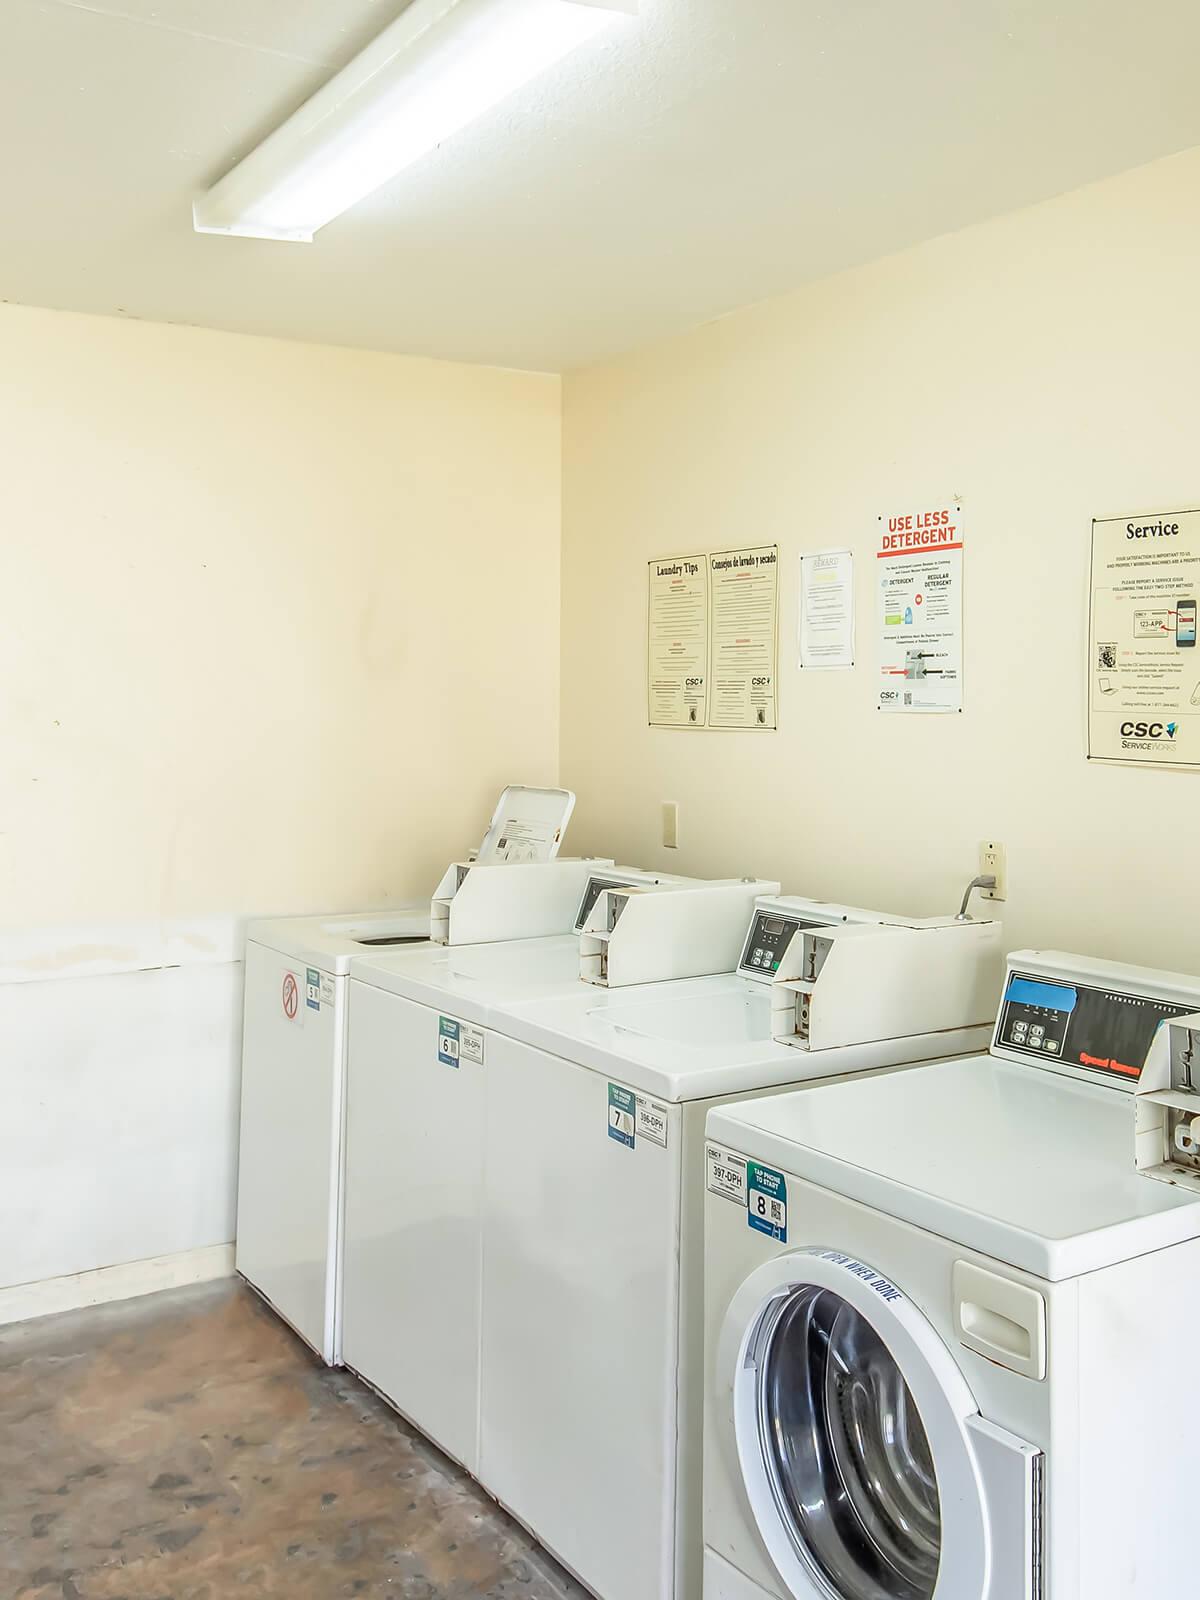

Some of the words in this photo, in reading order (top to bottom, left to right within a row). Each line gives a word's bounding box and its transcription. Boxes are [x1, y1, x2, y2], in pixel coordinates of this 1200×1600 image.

[889, 516, 912, 532] USE
[917, 511, 948, 528] LESS
[1127, 521, 1179, 539] Service
[883, 527, 956, 549] DETERGENT
[656, 564, 683, 576] Laundry
[684, 562, 698, 575] Tips
[712, 558, 732, 571] Consejos
[733, 556, 738, 566] de
[739, 555, 755, 566] lavado
[756, 557, 758, 568] y
[760, 552, 776, 564] secado
[752, 677, 766, 685] CSC
[1120, 722, 1163, 737] CSC
[310, 987, 313, 998] 5
[1105, 994, 1145, 1006] PERMANENT
[1154, 1004, 1176, 1013] PRESS
[444, 1039, 448, 1052] 6
[615, 1110, 620, 1126] 7
[714, 1166, 741, 1186] 397-DPH
[764, 1179, 778, 1190] START
[757, 1196, 765, 1215] 8
[821, 1252, 849, 1264] OPEN
[845, 1261, 878, 1280] WHEN
[870, 1280, 902, 1302] DONE
